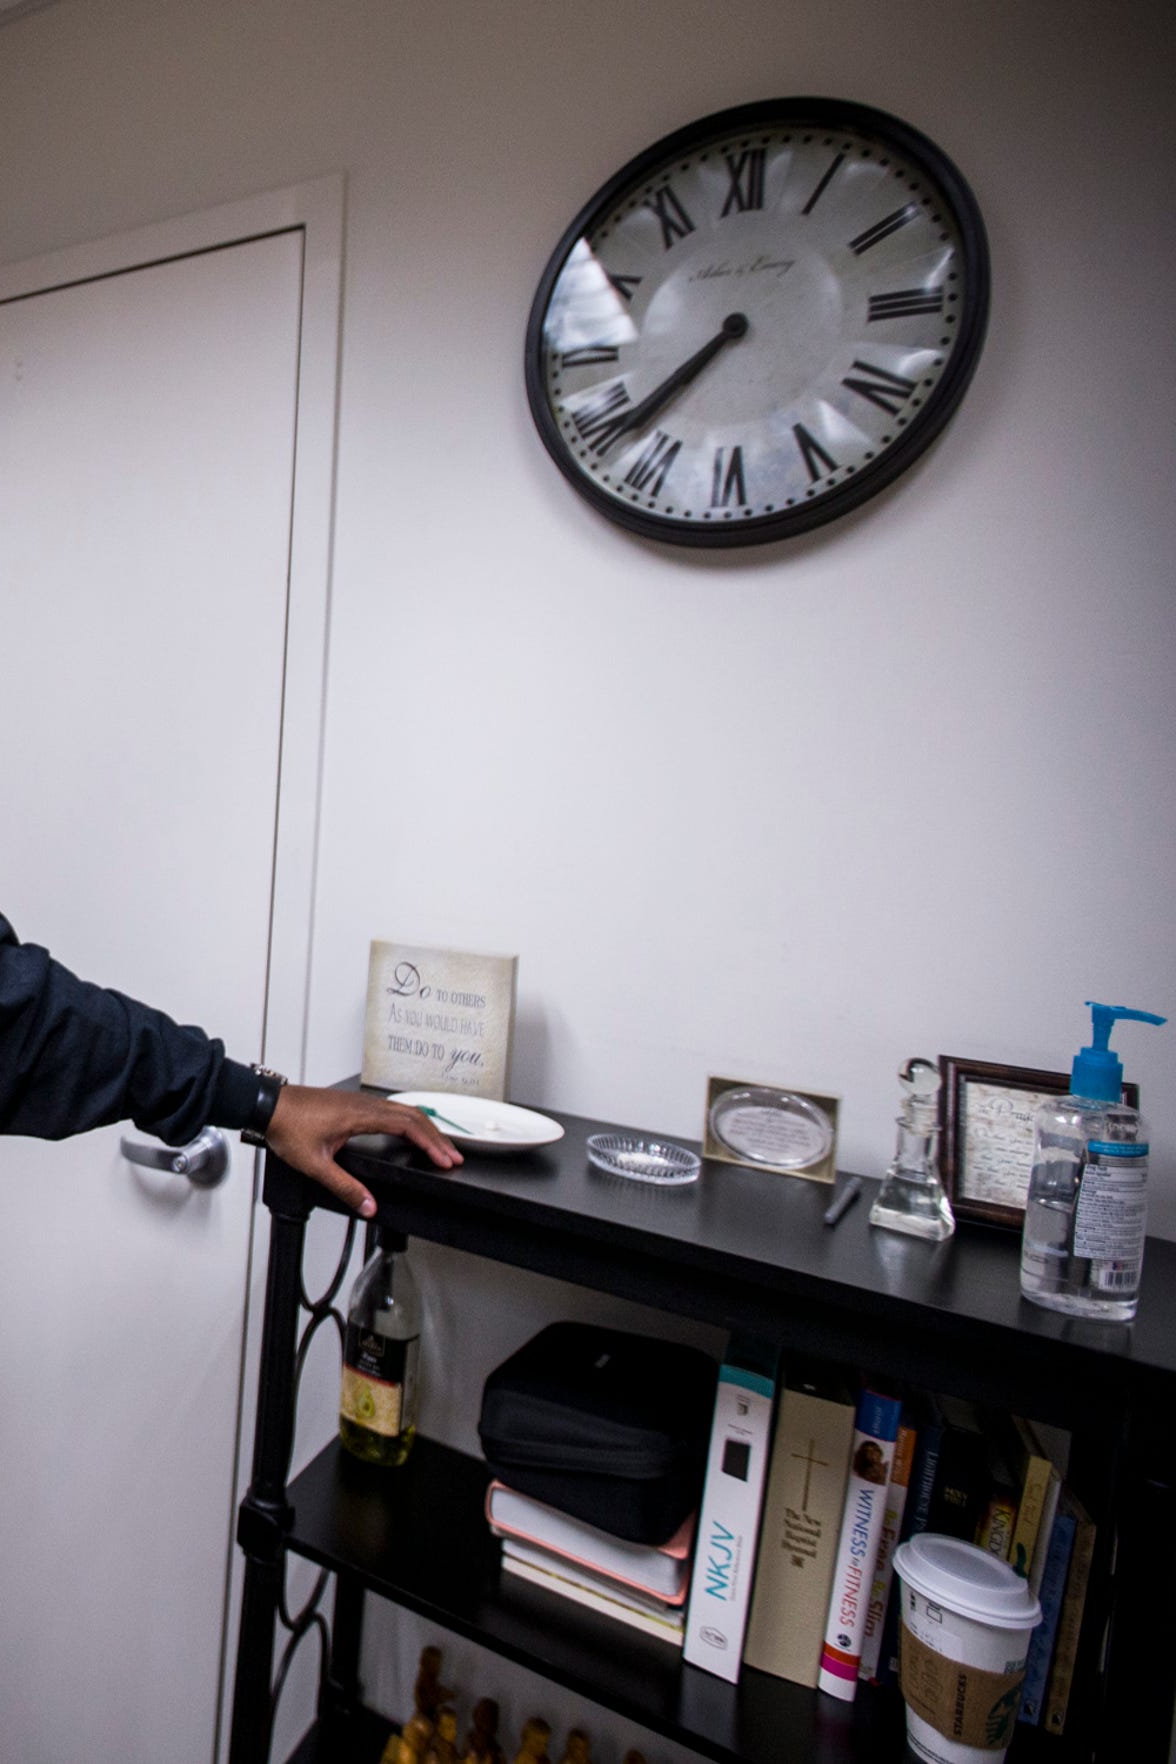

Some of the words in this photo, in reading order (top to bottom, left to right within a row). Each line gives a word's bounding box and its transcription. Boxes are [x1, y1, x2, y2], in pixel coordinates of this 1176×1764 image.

[720, 148, 766, 219] XII
[645, 184, 696, 252] XI
[867, 285, 944, 323] III
[711, 446, 747, 508] VI
[792, 422, 840, 482] V
[386, 961, 432, 1000] Do
[437, 989, 449, 1002] TO
[451, 991, 487, 1009] OTHERS
[388, 1035, 413, 1056] THEM
[415, 1040, 430, 1057] DO
[431, 1043, 446, 1061] TO
[405, 1009, 423, 1028] YOU
[425, 1013, 458, 1033] WOULD
[460, 1018, 485, 1037] HAVE
[850, 1489, 874, 1558] WITNESS
[874, 1526, 896, 1573] Free
[704, 1520, 735, 1601] NKJV
[839, 1565, 862, 1628] FITNESS
[864, 1594, 884, 1637] Slim
[953, 1672, 967, 1736] STARBUCKS
